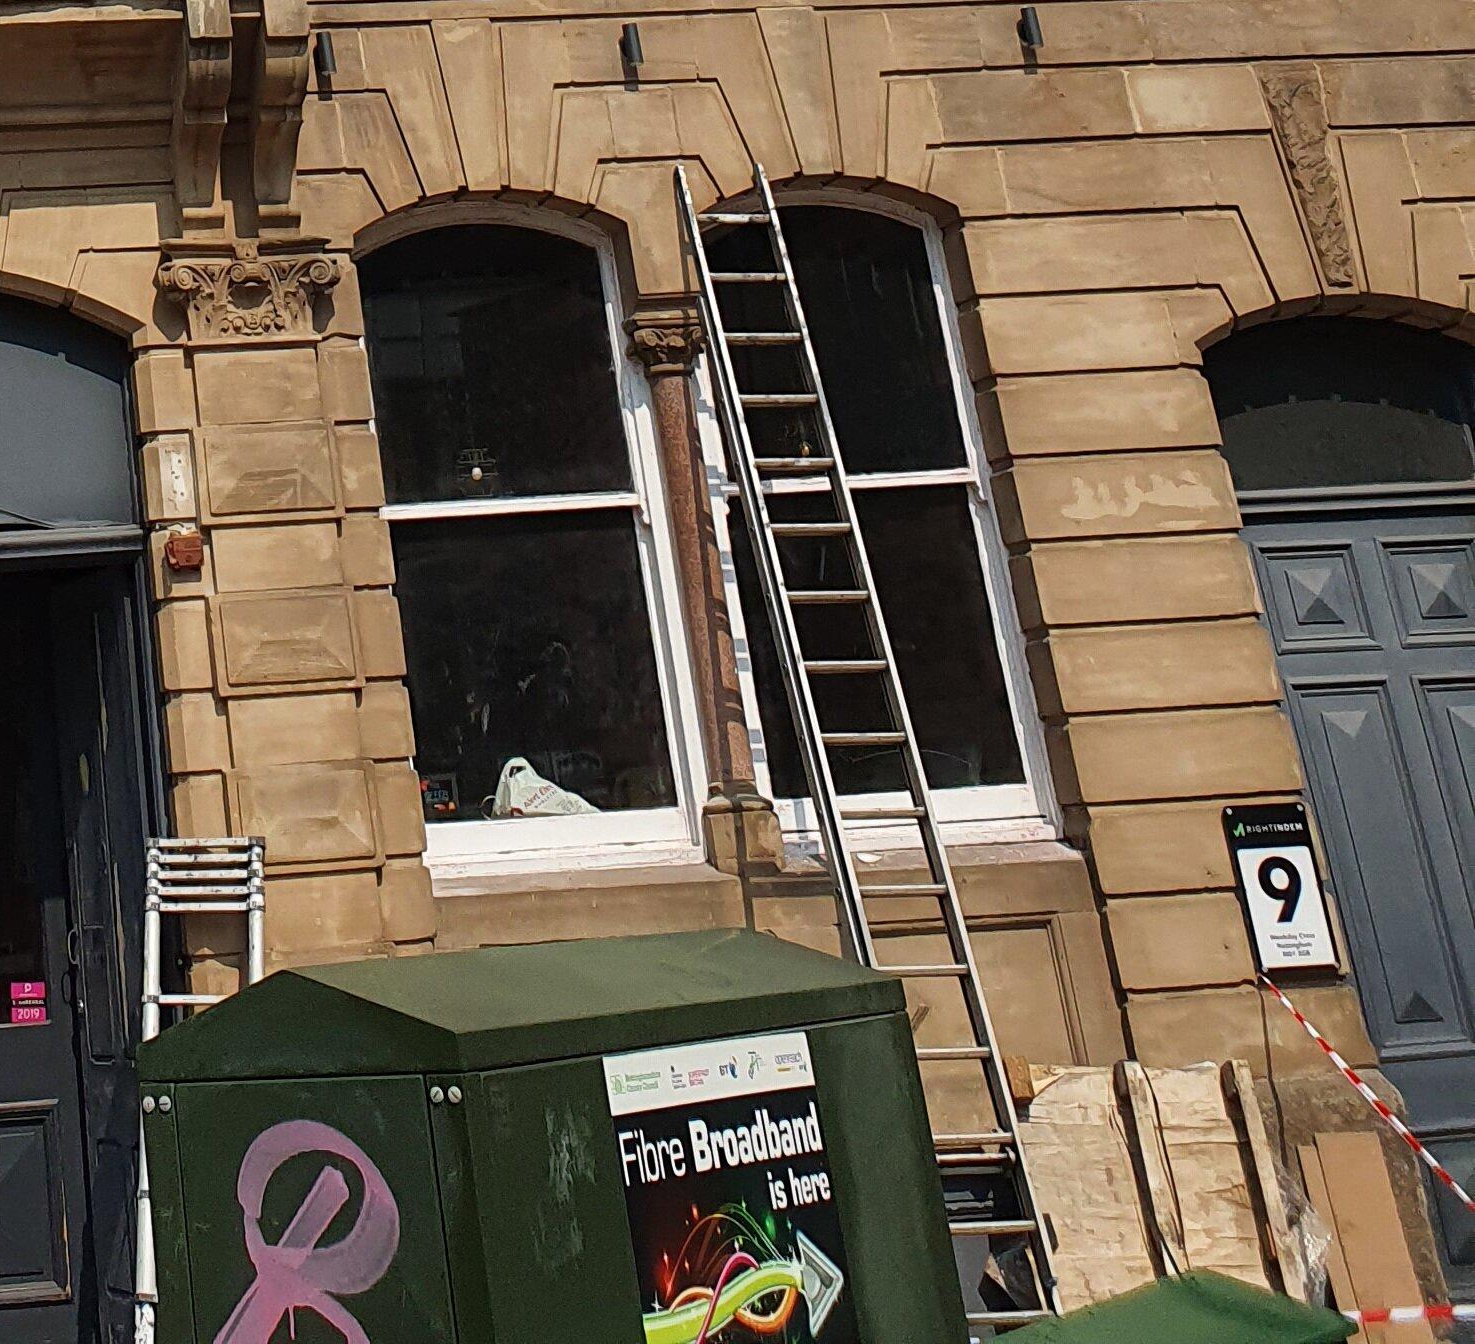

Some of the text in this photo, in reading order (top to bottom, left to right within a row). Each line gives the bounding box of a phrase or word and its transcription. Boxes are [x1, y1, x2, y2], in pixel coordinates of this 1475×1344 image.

[1257, 856, 1302, 923] 9
[17, 1008, 40, 1020] 2019
[618, 1101, 823, 1186] Fibre Broadband
[767, 1167, 831, 1210] is here
